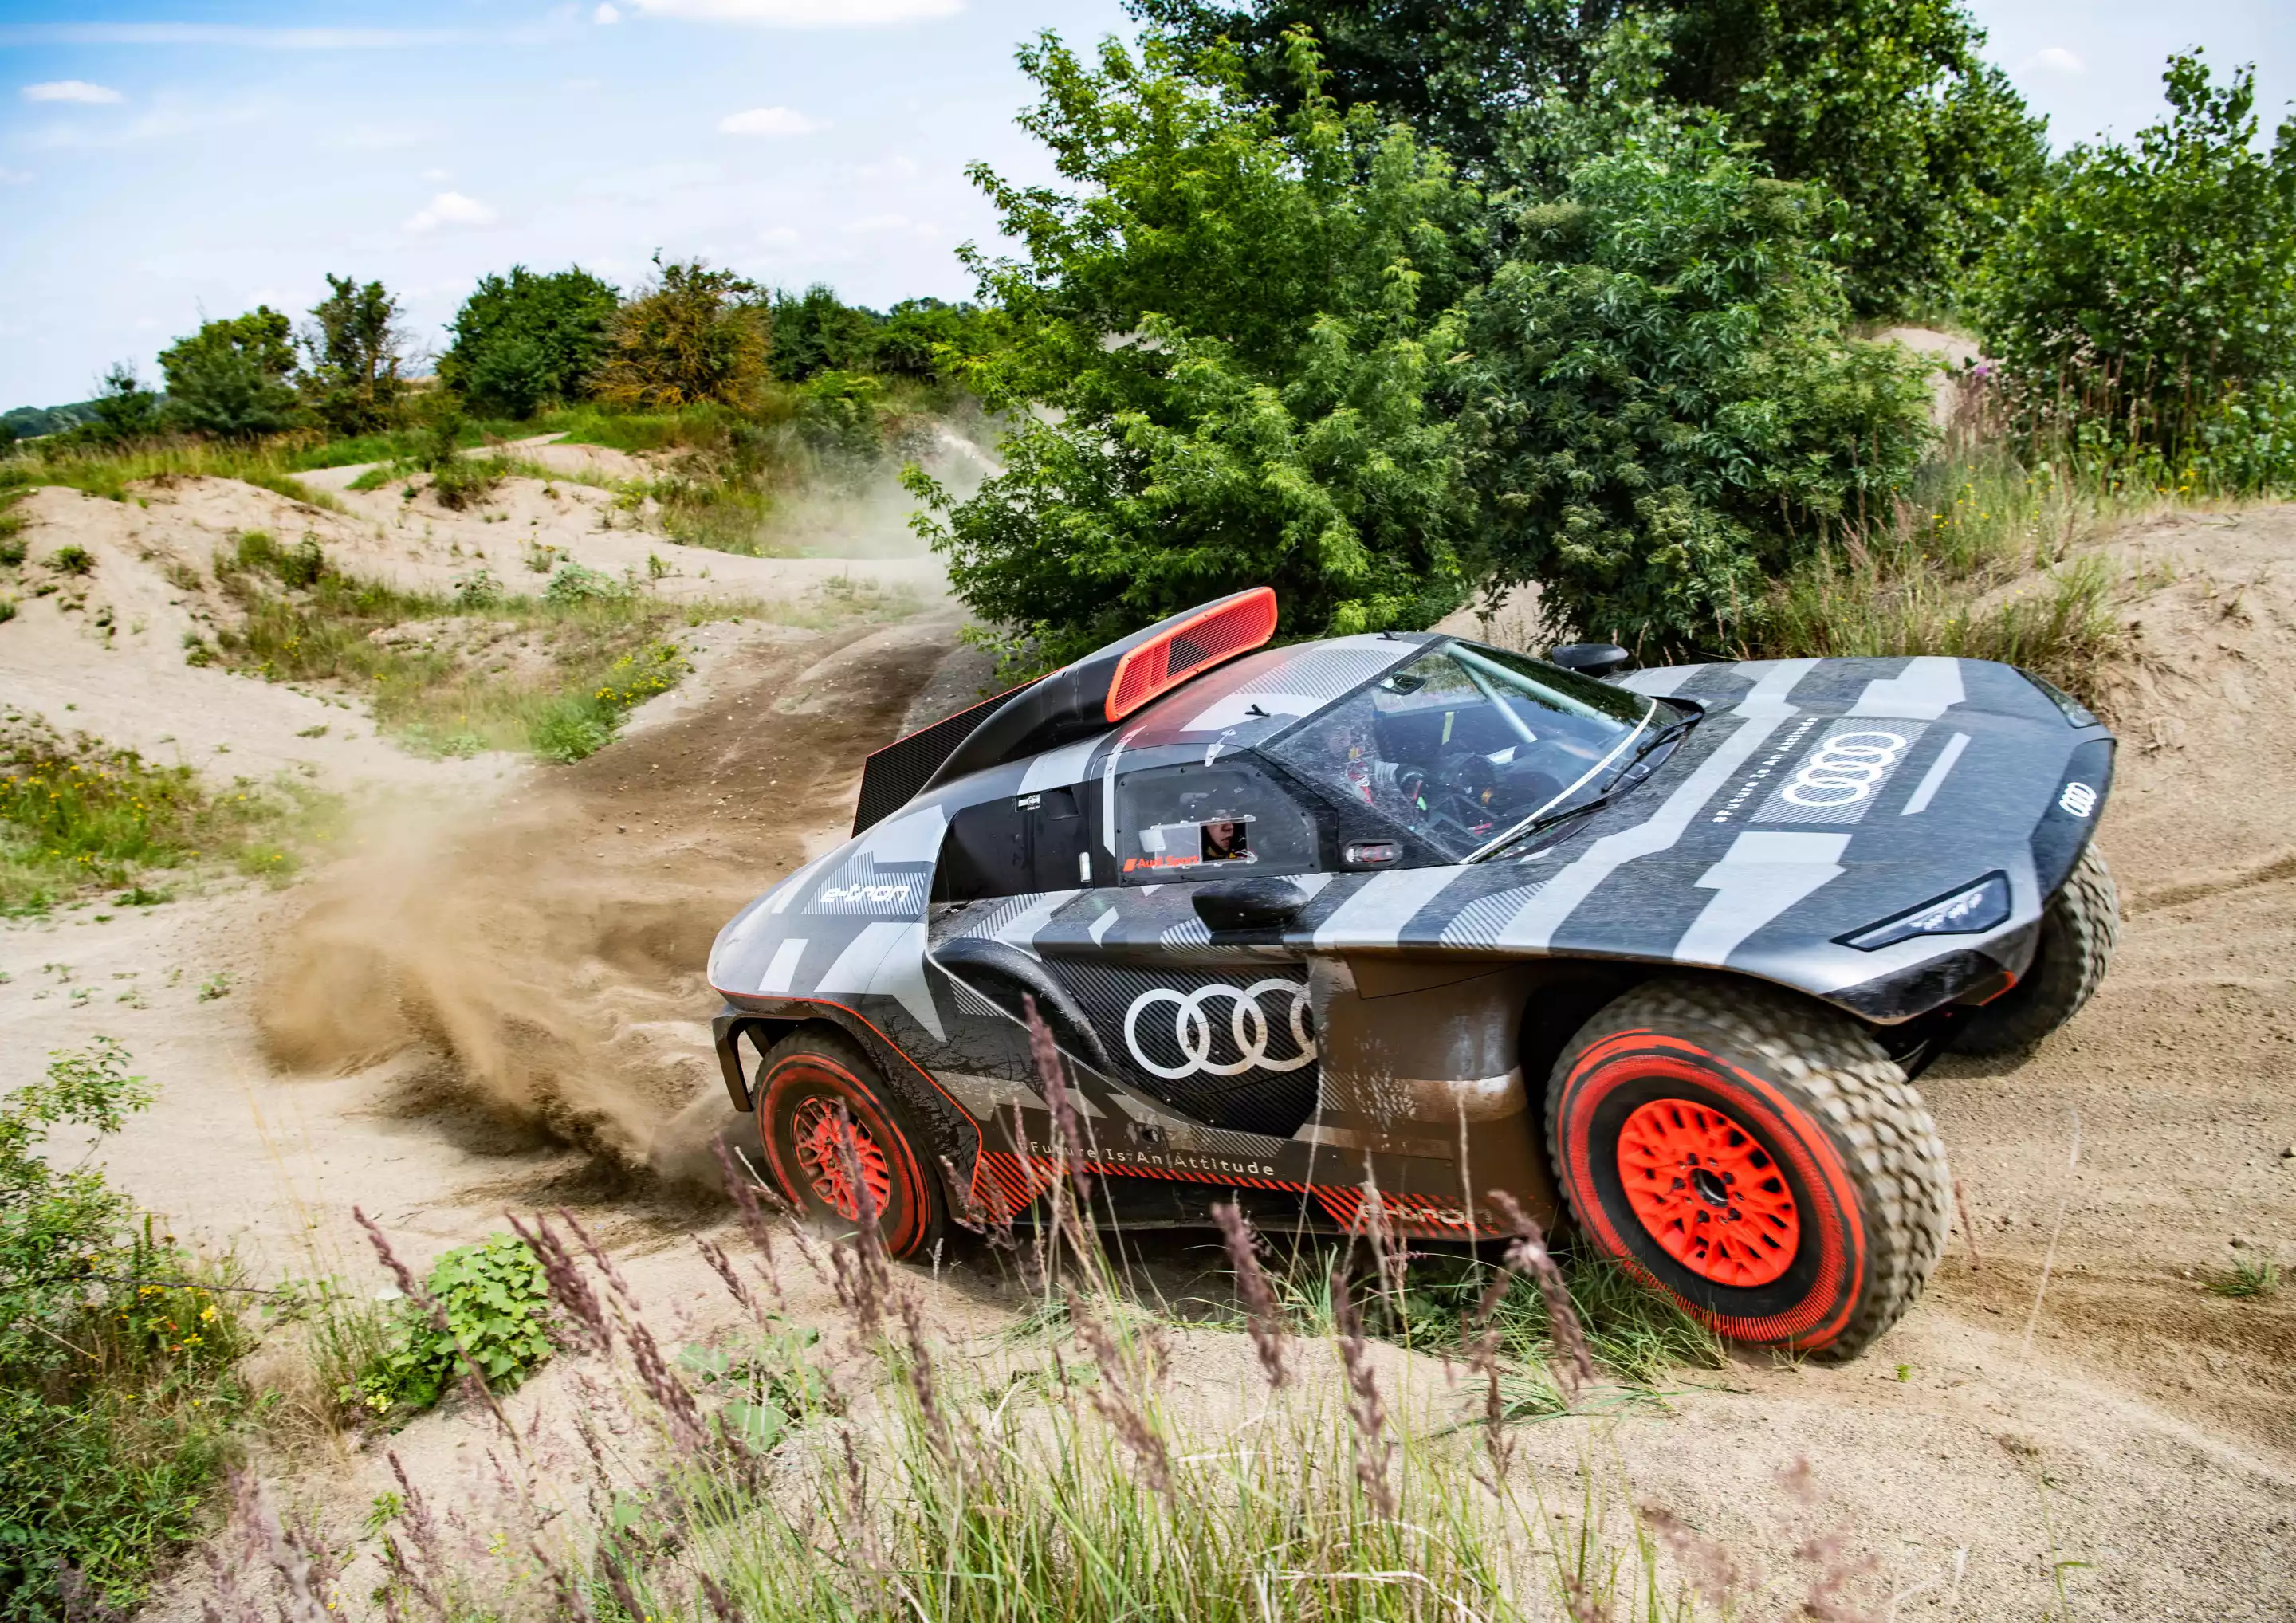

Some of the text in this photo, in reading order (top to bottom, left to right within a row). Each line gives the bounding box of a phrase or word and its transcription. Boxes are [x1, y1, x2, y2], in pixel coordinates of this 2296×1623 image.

[1762, 754, 1785, 766] An
[1775, 717, 1819, 752] Attitude
[1137, 855, 1199, 869] Audi Sport
[820, 883, 910, 903] e-tron
[1105, 1148, 1126, 1161] Is
[1137, 1151, 1162, 1165] An
[1174, 1153, 1275, 1176] Attitude
